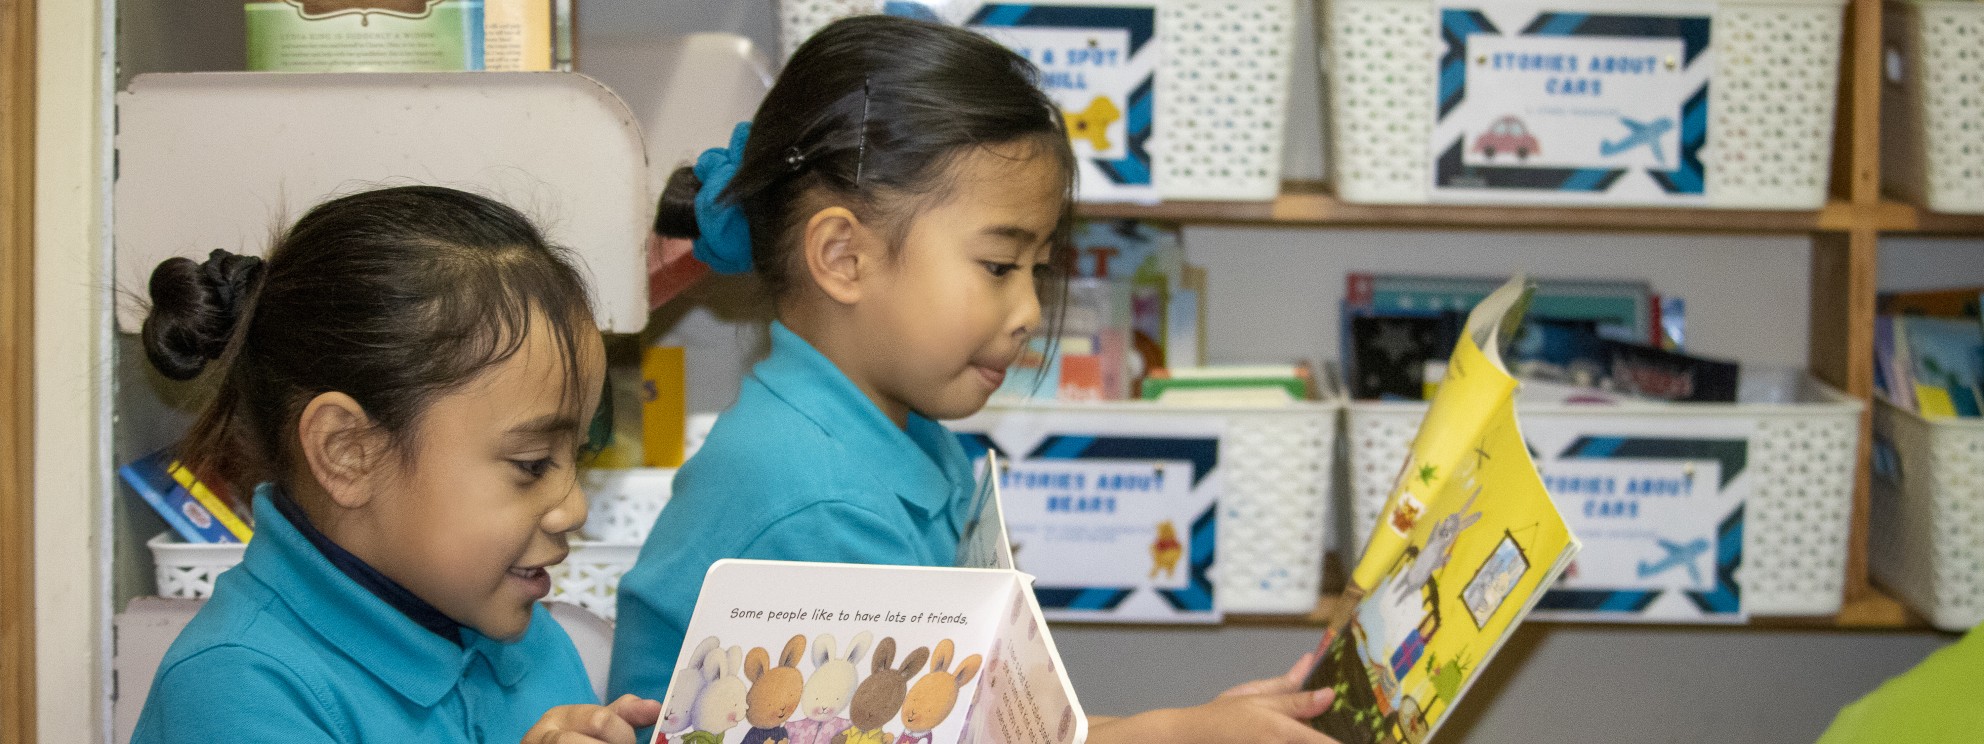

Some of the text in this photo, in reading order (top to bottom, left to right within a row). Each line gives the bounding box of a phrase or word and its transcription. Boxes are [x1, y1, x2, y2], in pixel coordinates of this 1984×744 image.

[1067, 48, 1118, 66] SPOT
[1493, 52, 1657, 75] STORIES ABOUT
[1546, 77, 1602, 96] CARS
[1001, 470, 1164, 492] STORIES ABOUT
[1544, 475, 1693, 496] TORIES ABOUT
[1047, 497, 1116, 513] BEARS
[1584, 500, 1638, 518] CARS
[730, 607, 968, 626] Some people like to have lots of friends,
